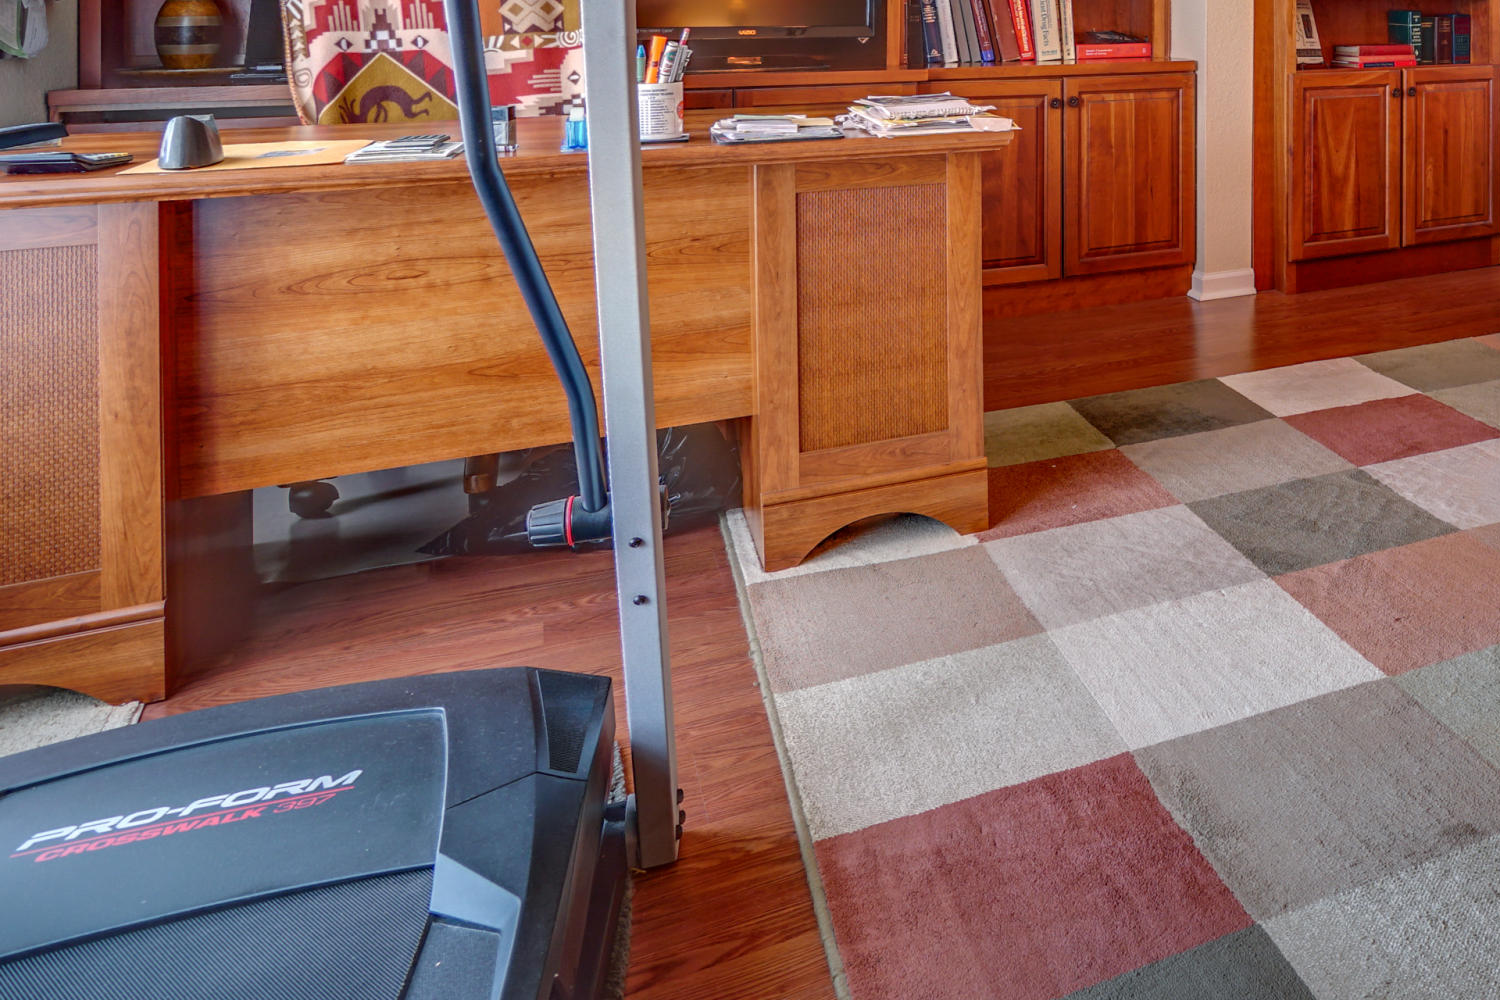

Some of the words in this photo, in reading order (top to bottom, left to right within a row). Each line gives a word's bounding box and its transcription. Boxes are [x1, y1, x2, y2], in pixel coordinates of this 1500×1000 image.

[16, 769, 363, 851] PRO-FORM
[34, 807, 265, 862] CROSSWALK
[273, 793, 337, 814] 397
